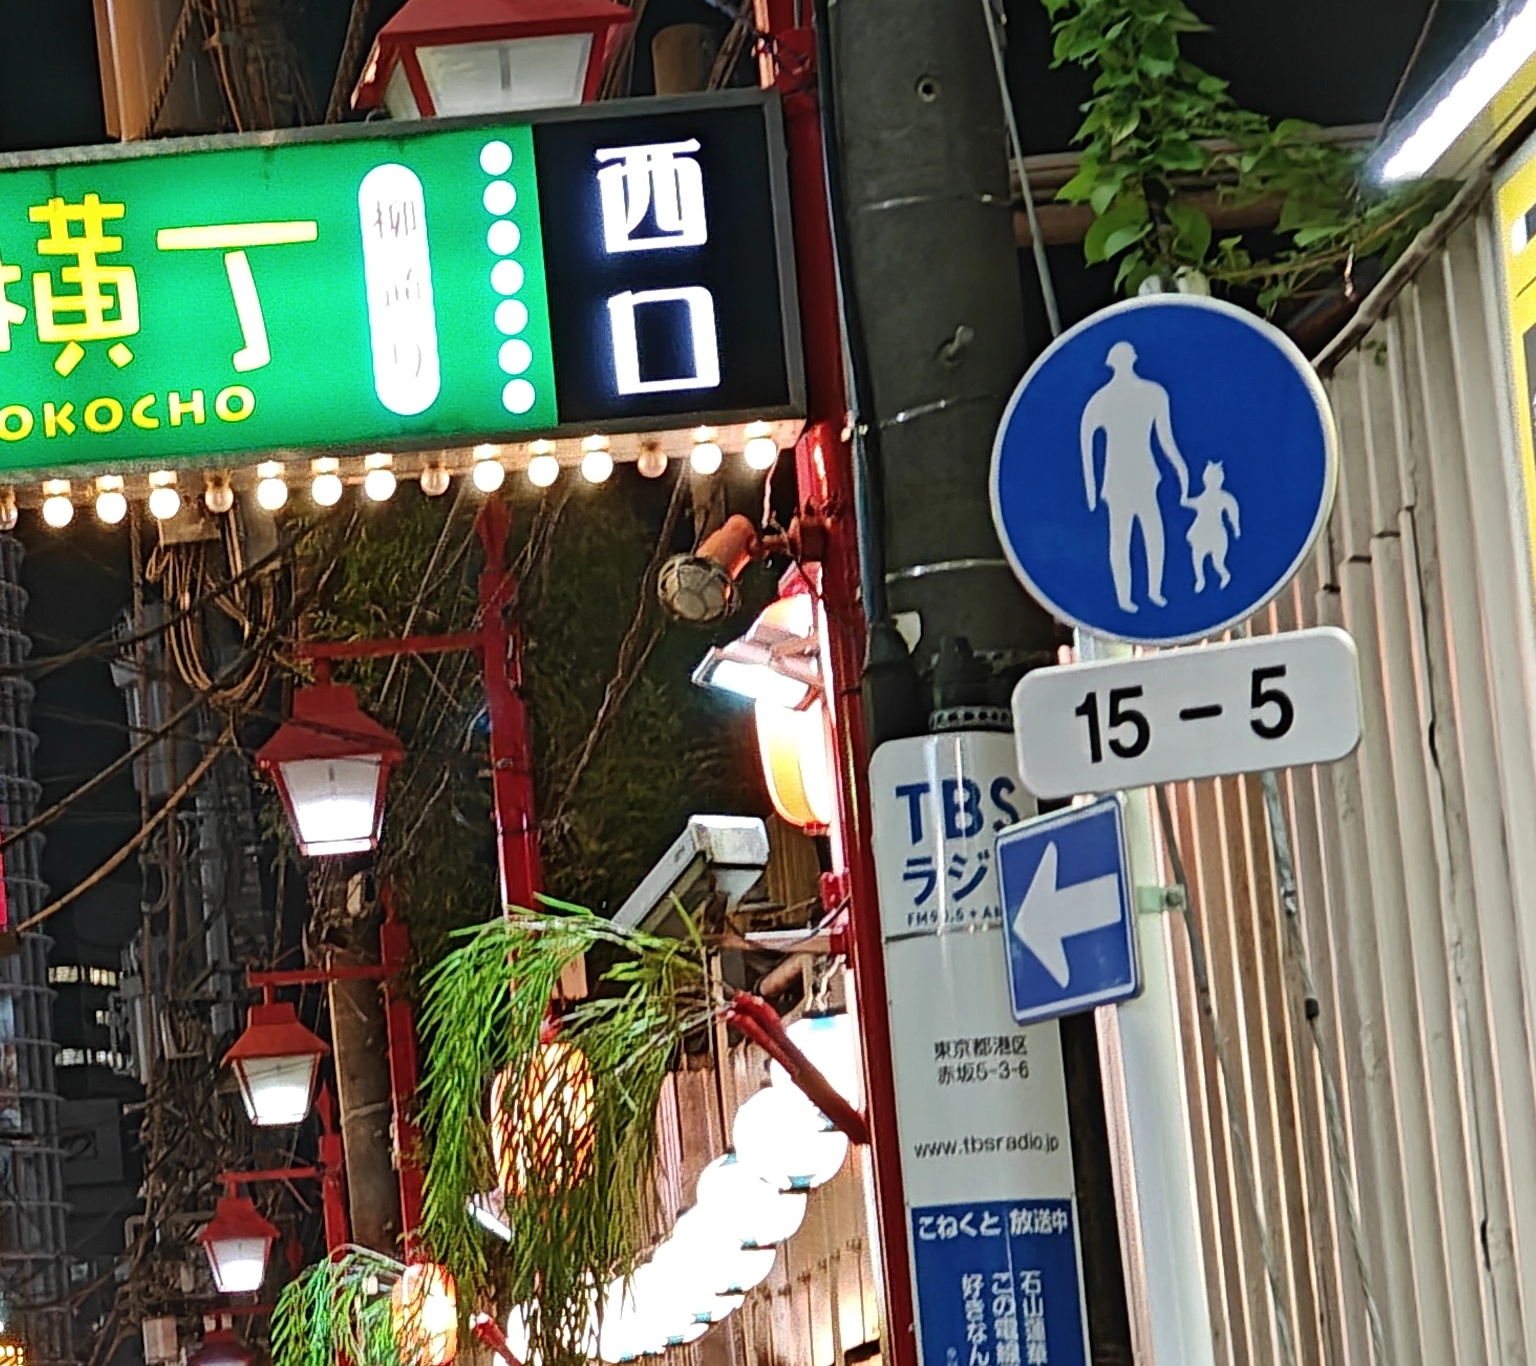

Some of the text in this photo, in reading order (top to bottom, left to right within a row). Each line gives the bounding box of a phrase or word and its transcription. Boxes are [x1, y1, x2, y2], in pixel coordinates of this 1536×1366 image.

[595, 137, 721, 396] 西口
[895, 776, 1021, 845] TBS
[935, 1035, 1028, 1060] 東京都港区
[938, 1059, 1030, 1086] 赤坂5-3-6
[914, 1133, 1060, 1160] www.tbsradio.jp
[919, 1206, 1069, 1241] こねくと 放送中
